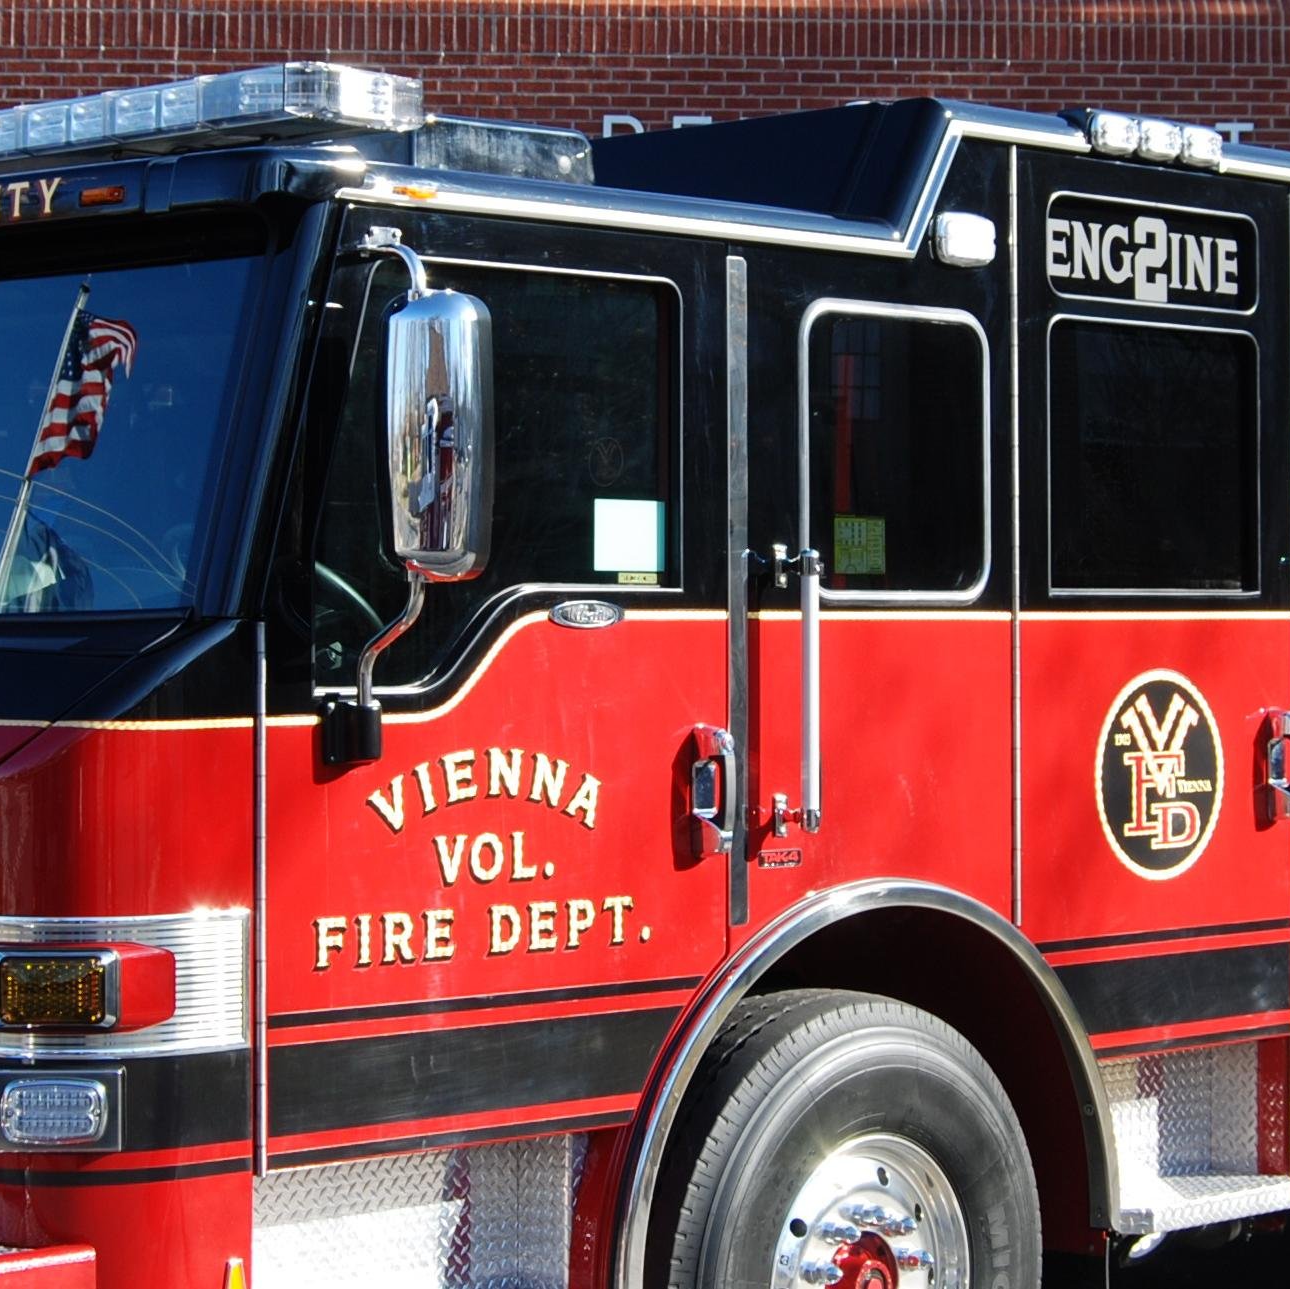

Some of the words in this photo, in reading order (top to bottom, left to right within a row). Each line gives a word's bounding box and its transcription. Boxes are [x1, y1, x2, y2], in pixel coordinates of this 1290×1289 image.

[366, 747, 602, 834] VIENNA
[432, 831, 555, 888] VOL.
[312, 908, 457, 972] FIRE
[486, 896, 652, 957] DEPT.
